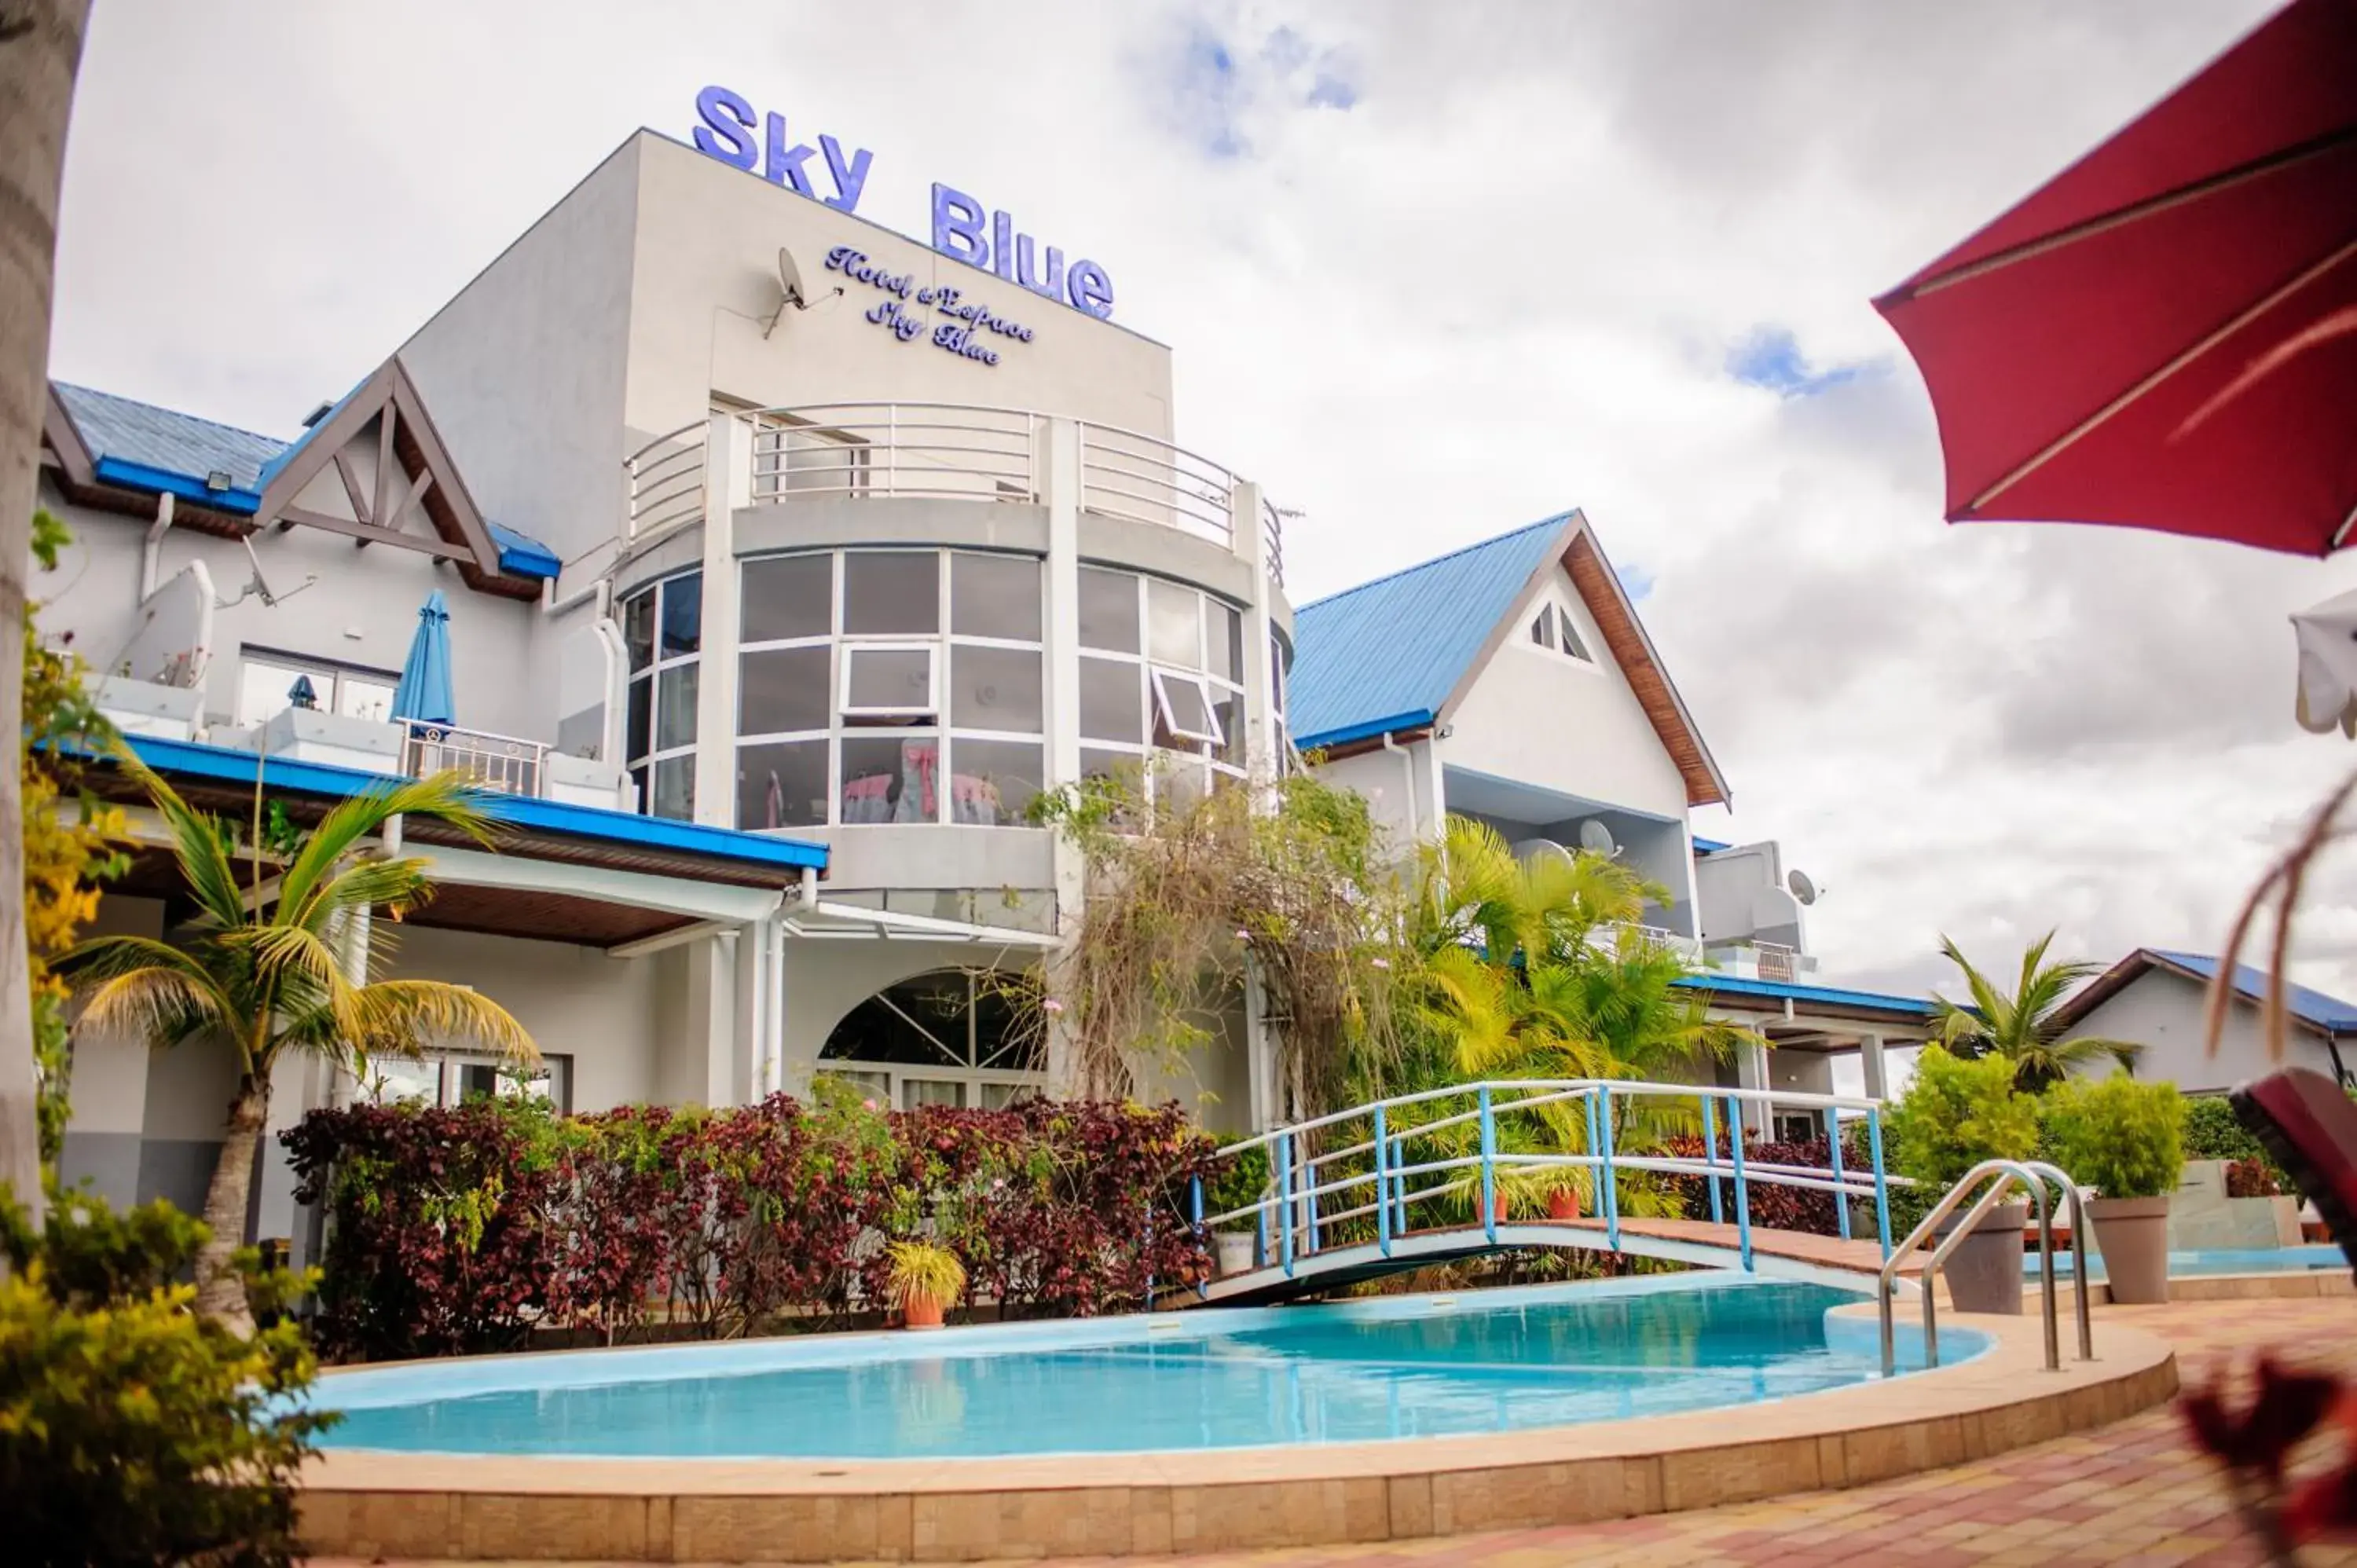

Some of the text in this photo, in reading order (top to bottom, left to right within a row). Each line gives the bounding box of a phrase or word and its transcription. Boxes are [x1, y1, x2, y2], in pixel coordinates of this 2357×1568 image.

[691, 85, 1113, 321] Sky Blue
[824, 245, 913, 300] Hotel
[865, 301, 1002, 366] Sky Blue
